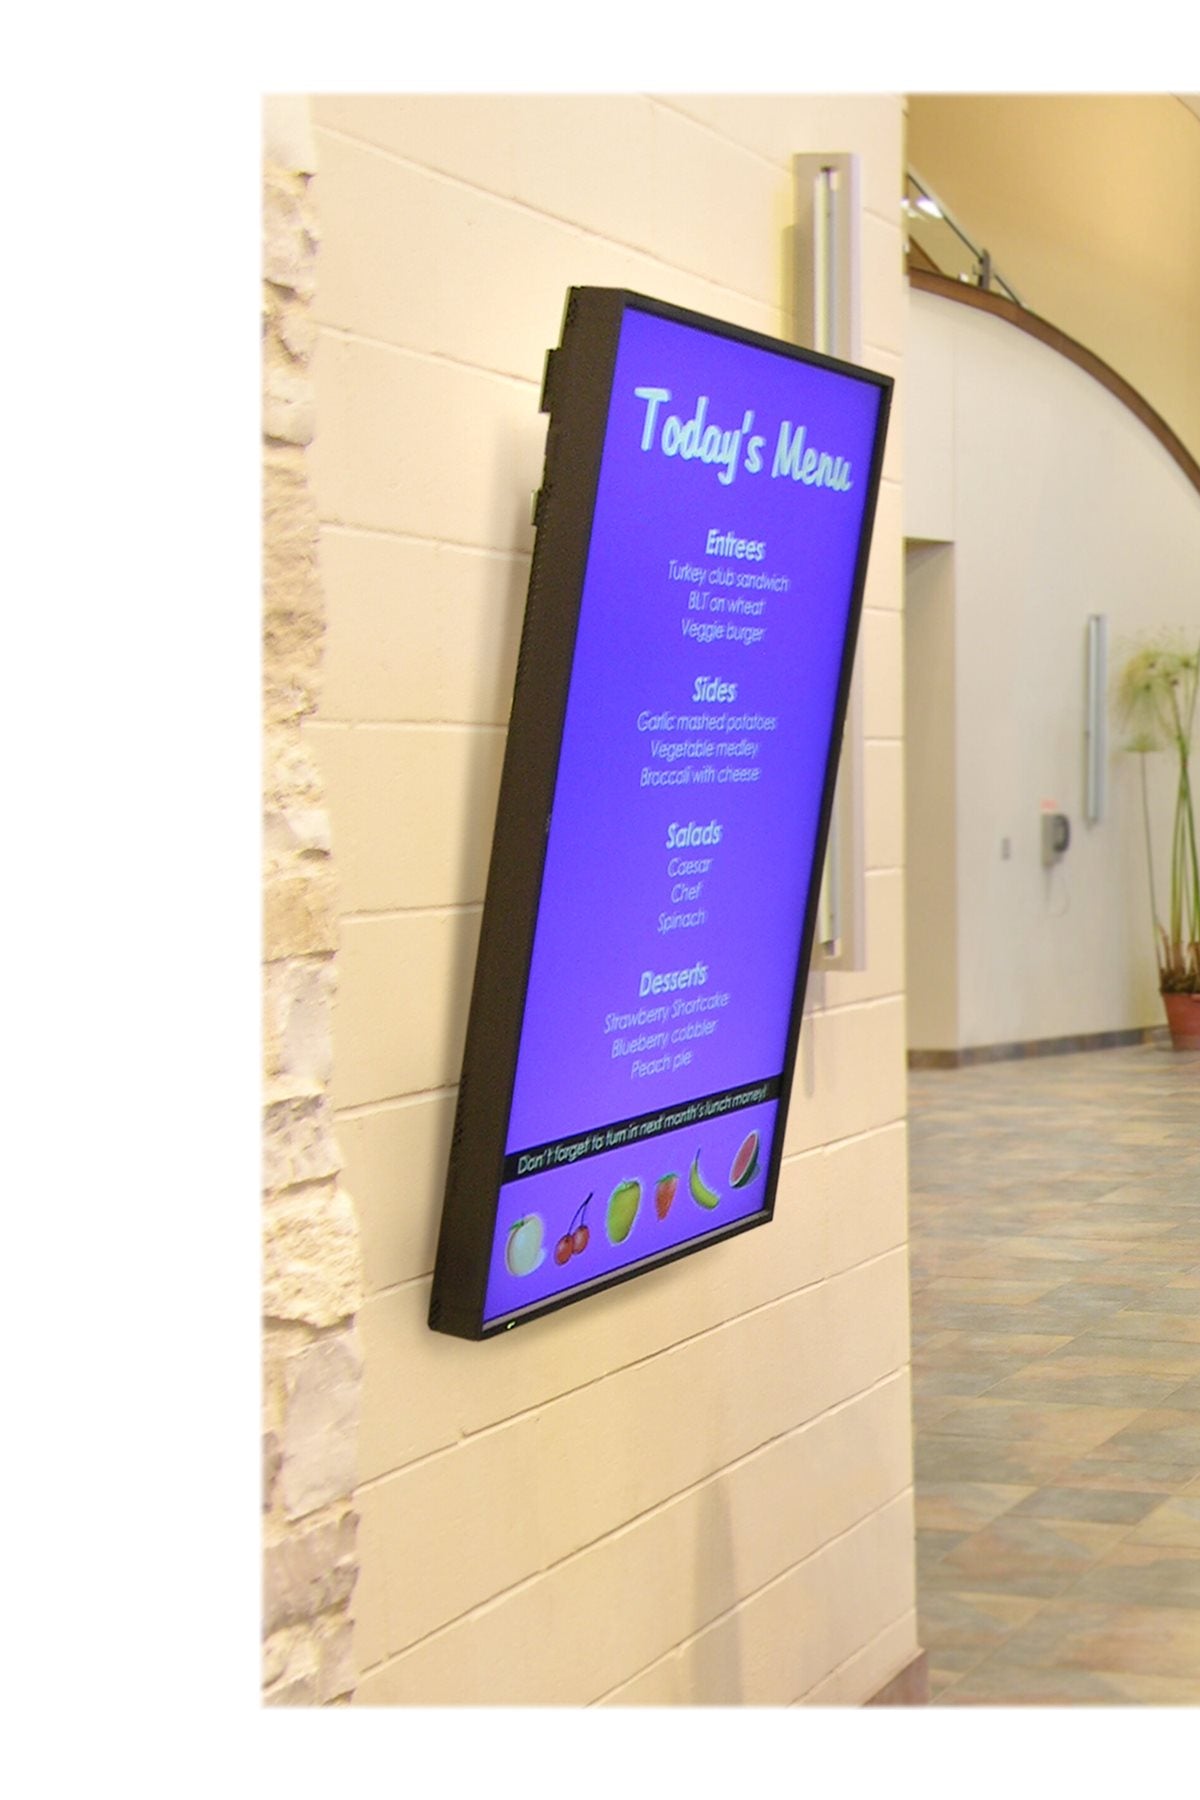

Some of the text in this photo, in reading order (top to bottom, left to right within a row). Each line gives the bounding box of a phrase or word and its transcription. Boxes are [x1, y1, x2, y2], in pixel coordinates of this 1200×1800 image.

[634, 386, 854, 492] Today's Menu
[705, 528, 767, 562] Entrees
[668, 559, 790, 592] Turkey club sandwich
[688, 591, 710, 611] BLT
[727, 598, 765, 616] wheat
[681, 618, 767, 645] Veggie burger
[692, 675, 738, 702] Sides
[637, 710, 777, 733] Garlic mashed potatoes
[651, 739, 759, 762] Vegetable medley
[640, 764, 761, 788] Broccoli with cheese
[665, 820, 723, 849] Salads
[667, 856, 714, 878] Caesar
[671, 881, 704, 904] Chef
[657, 907, 707, 935] Spinach
[639, 961, 709, 998] Desserts
[603, 992, 731, 1035] Strawberry Shortcake
[611, 1020, 719, 1059] Blueberry cobbler
[631, 1049, 694, 1080] Peach pie
[518, 1148, 553, 1175] Don't
[553, 1136, 591, 1163] forget
[592, 1133, 605, 1151] to
[627, 1121, 641, 1140] in
[640, 1113, 665, 1135] next
